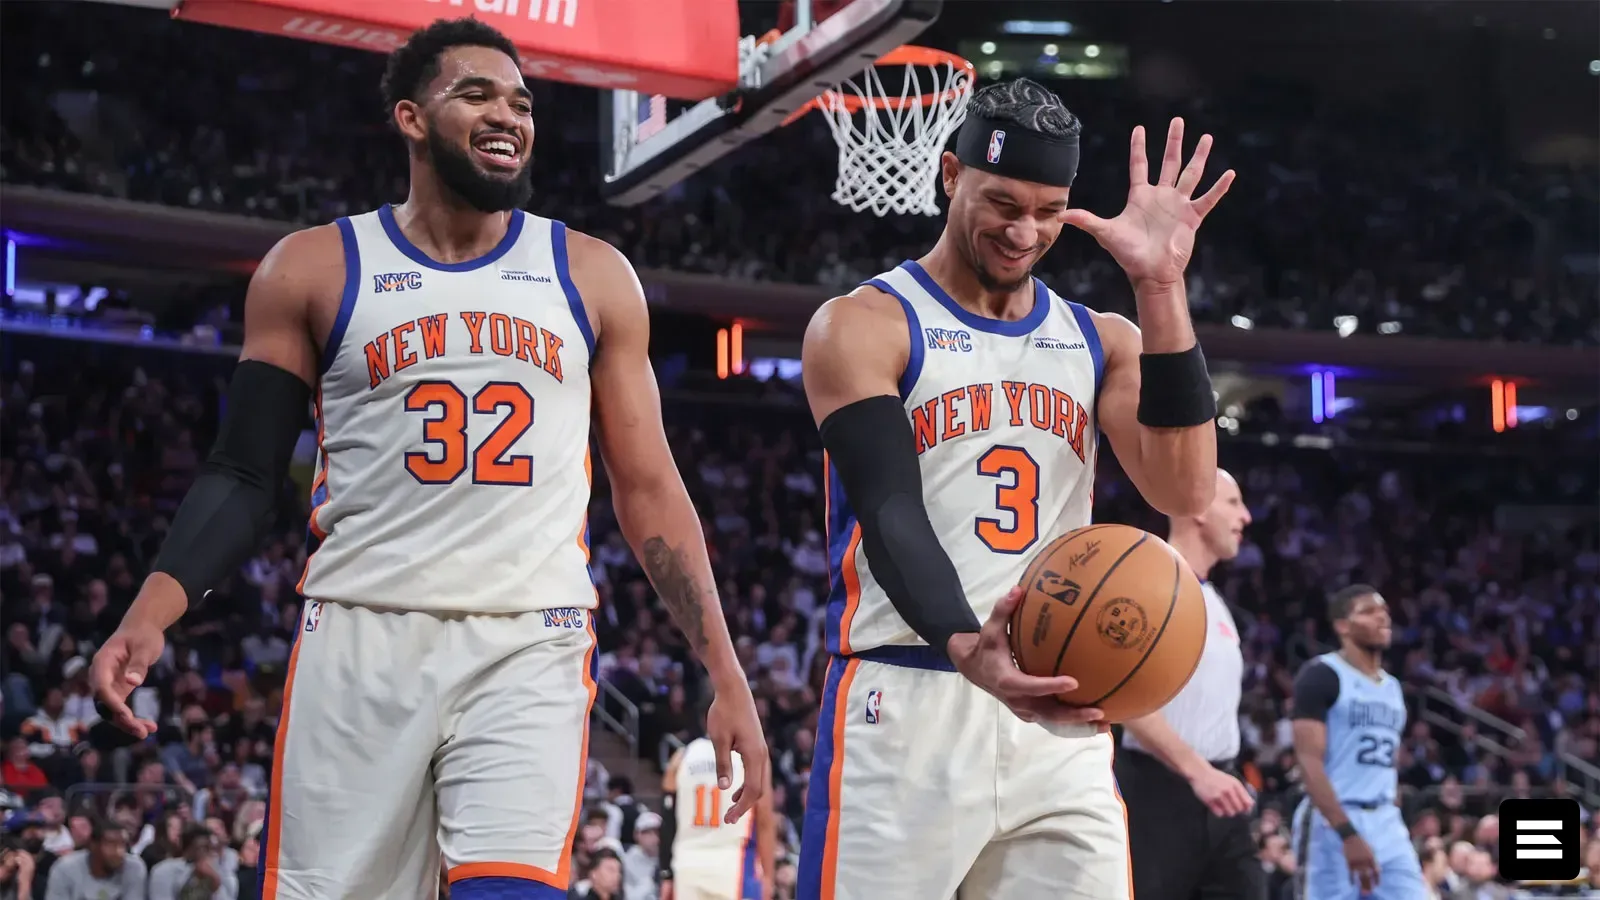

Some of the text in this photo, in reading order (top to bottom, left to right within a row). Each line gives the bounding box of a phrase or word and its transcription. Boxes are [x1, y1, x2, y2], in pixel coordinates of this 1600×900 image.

[374, 272, 422, 293] NYC
[522, 275, 551, 283] dhabi
[364, 312, 564, 391] NEW YORK
[925, 328, 972, 352] NYC
[1035, 341, 1085, 350] abu dhabi
[404, 380, 534, 486] 32
[912, 380, 1088, 464] NEW YORK
[974, 444, 1040, 555] 3
[541, 607, 583, 628] NYC
[1357, 734, 1394, 767] 23
[693, 785, 720, 828] 11
